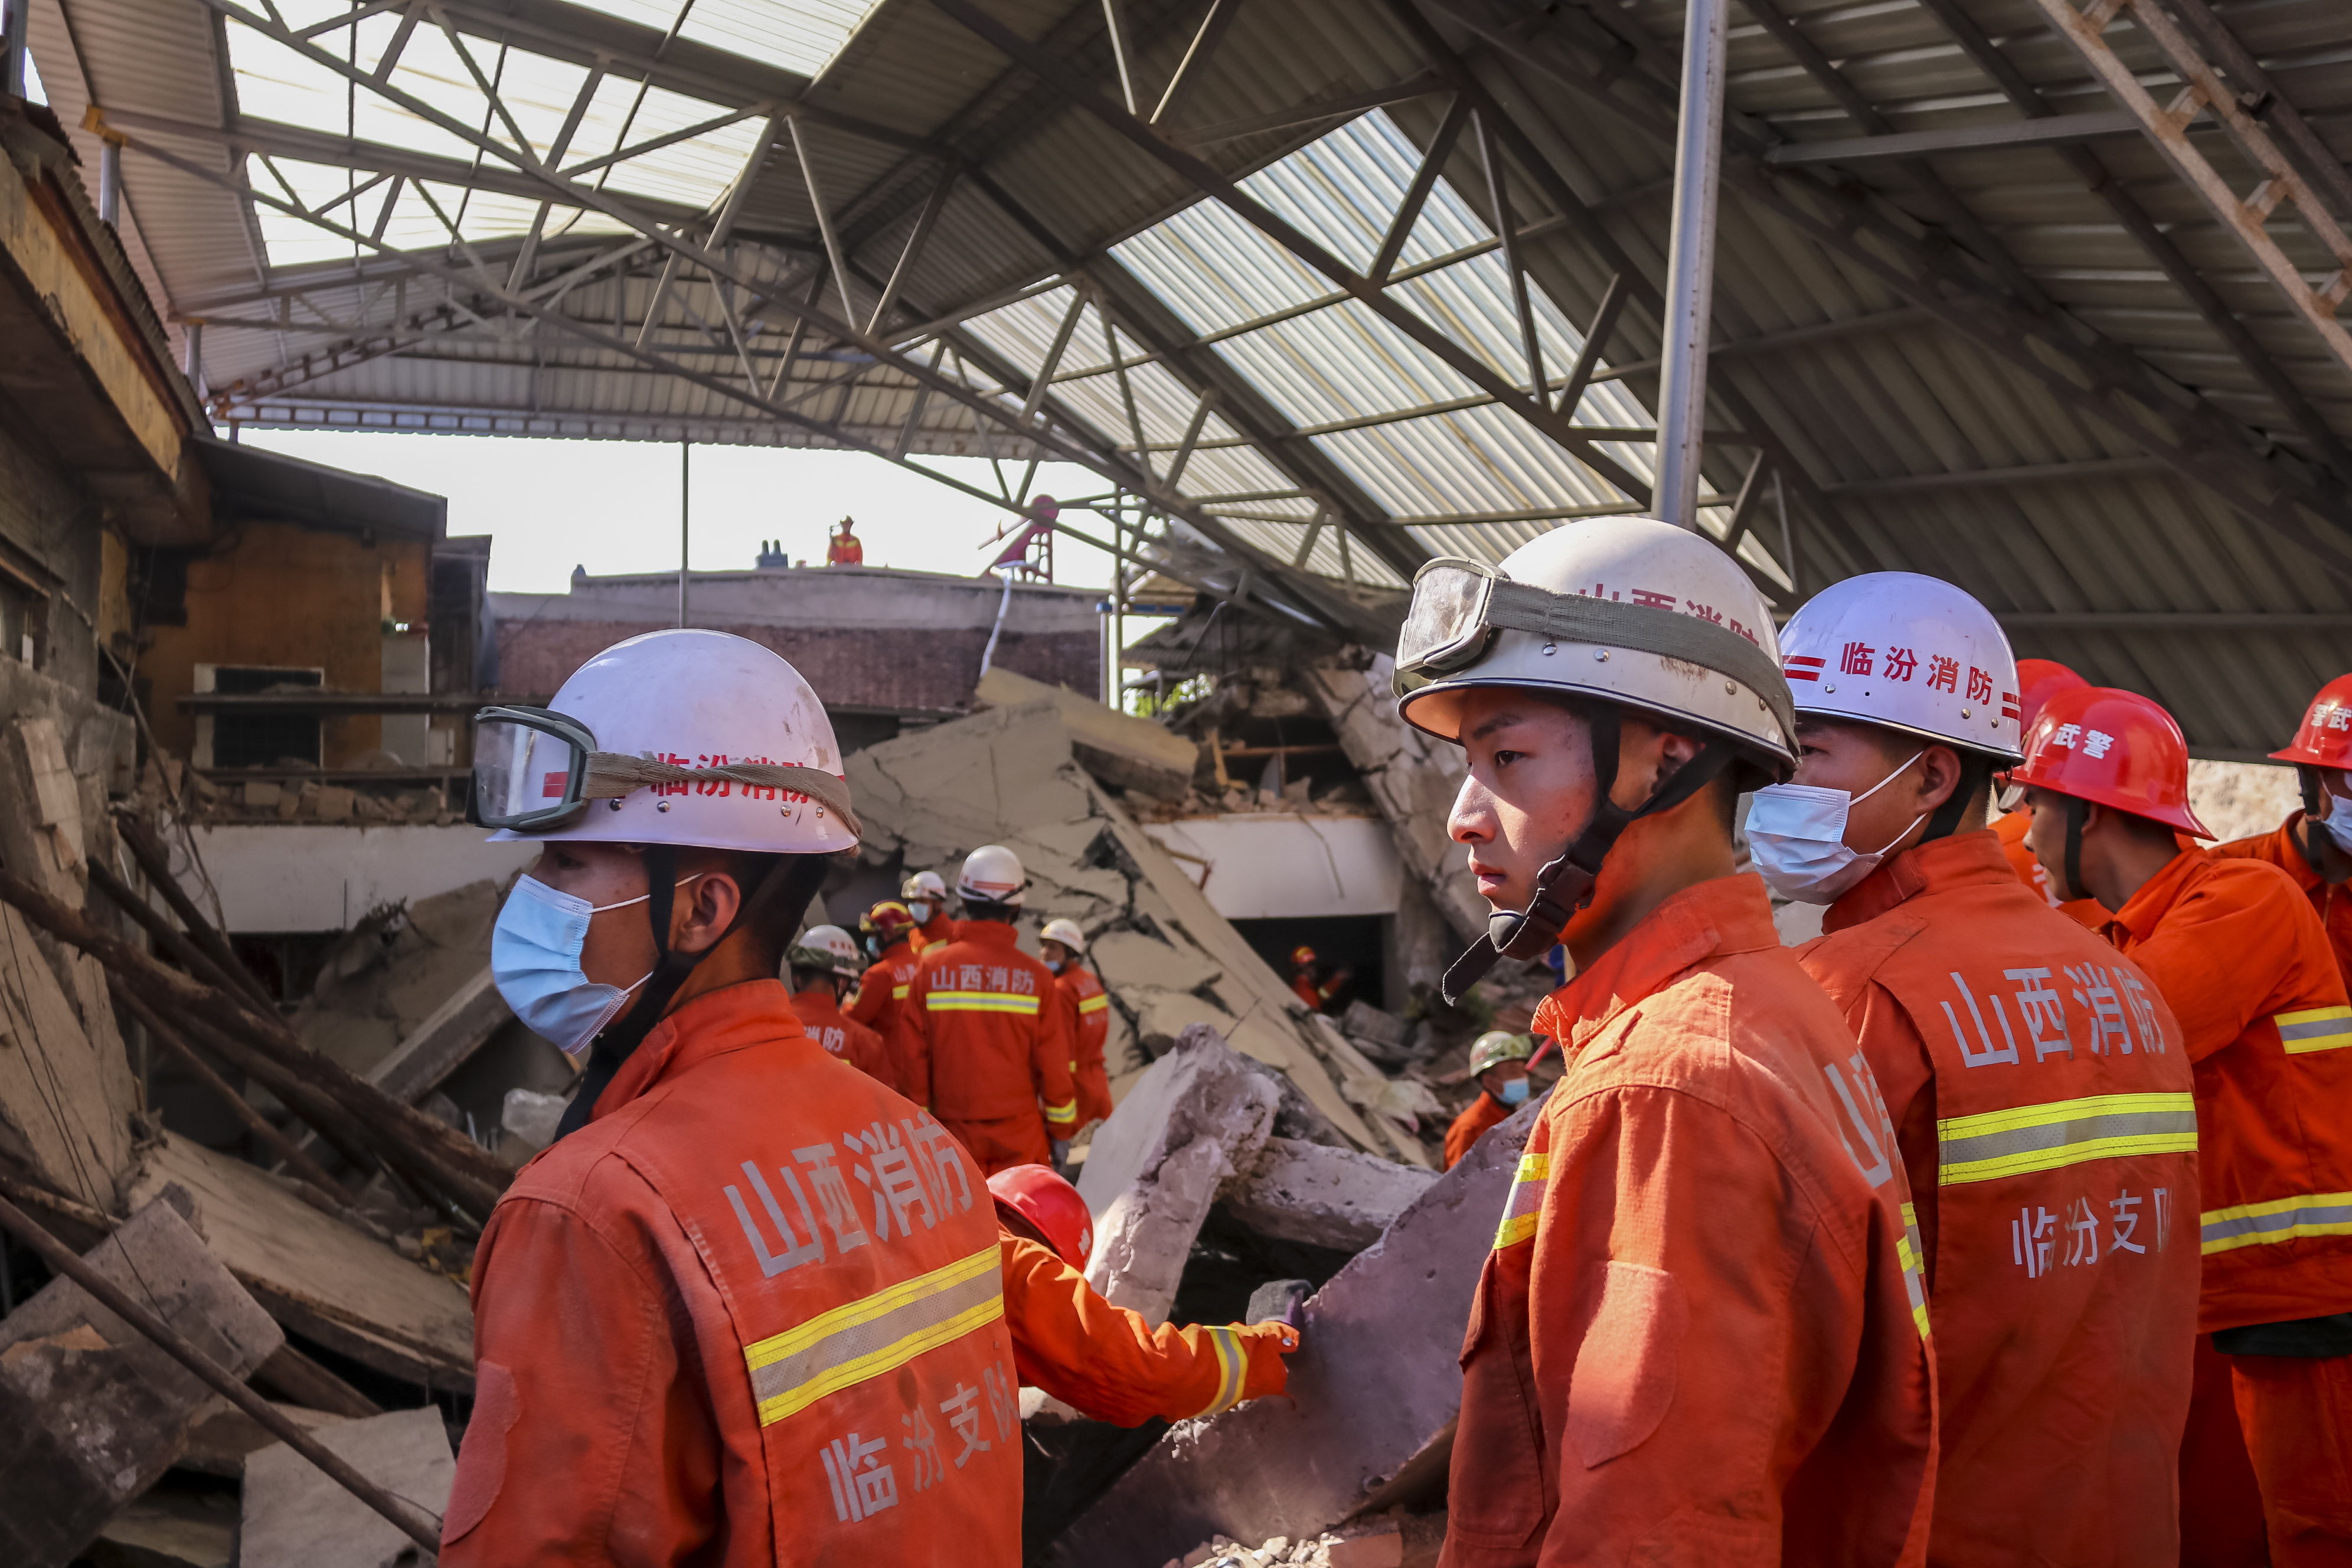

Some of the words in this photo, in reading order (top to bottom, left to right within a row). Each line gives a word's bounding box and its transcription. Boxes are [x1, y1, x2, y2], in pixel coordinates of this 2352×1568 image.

[1840, 642, 1993, 705] 临汾消防
[2052, 722, 2115, 760] 武警
[931, 963, 1035, 995] 山西消防
[1939, 961, 2166, 1068] 山西消防
[723, 1111, 974, 1279] 山西消防
